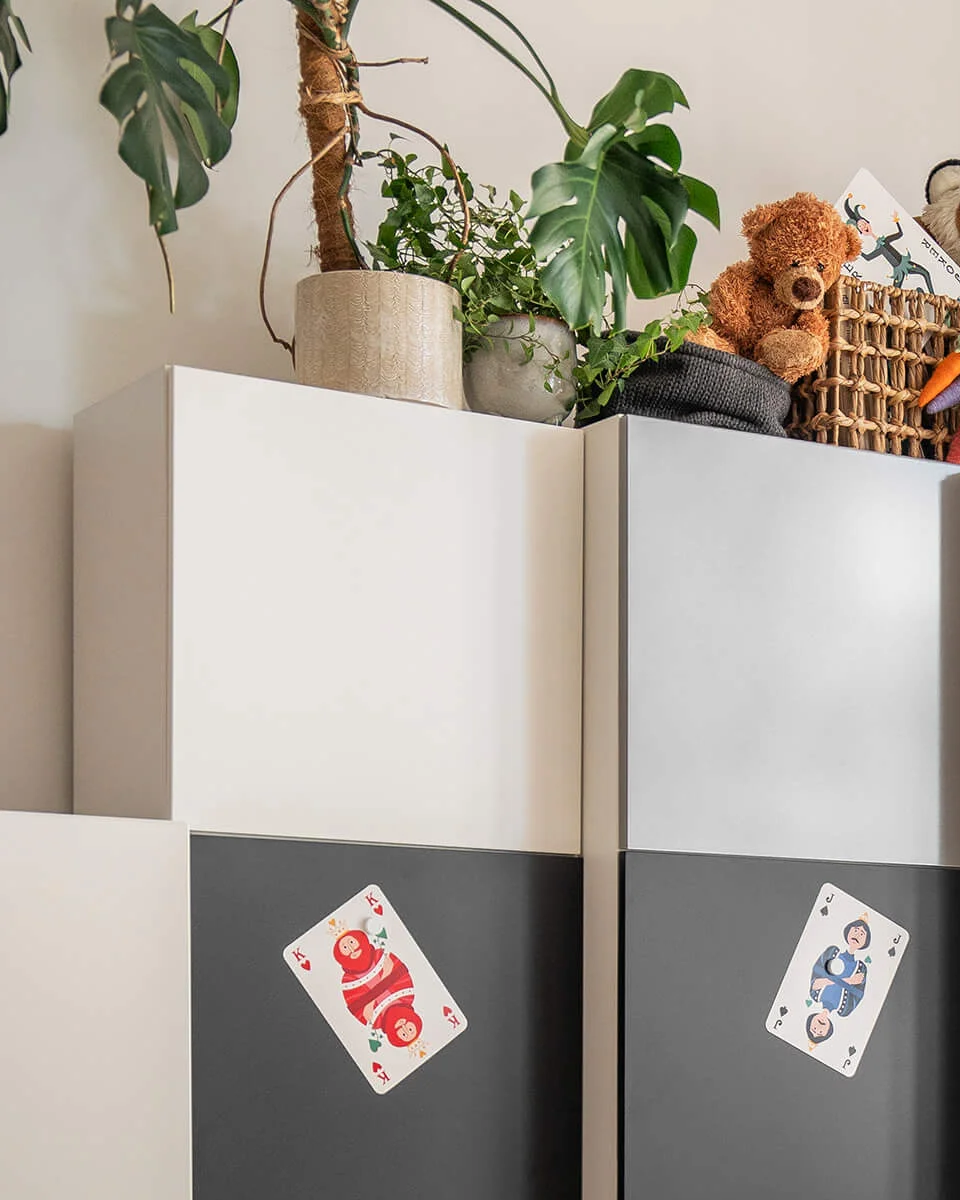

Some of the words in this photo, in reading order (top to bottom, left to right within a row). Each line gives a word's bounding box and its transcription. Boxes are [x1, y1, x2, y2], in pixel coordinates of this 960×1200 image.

[365, 892, 379, 906] K
[825, 893, 835, 903] J
[893, 935, 902, 944] J
[292, 947, 306, 962] K
[447, 1015, 461, 1029] K
[773, 1019, 783, 1029] J
[842, 1059, 851, 1069] J
[377, 1071, 391, 1085] K
